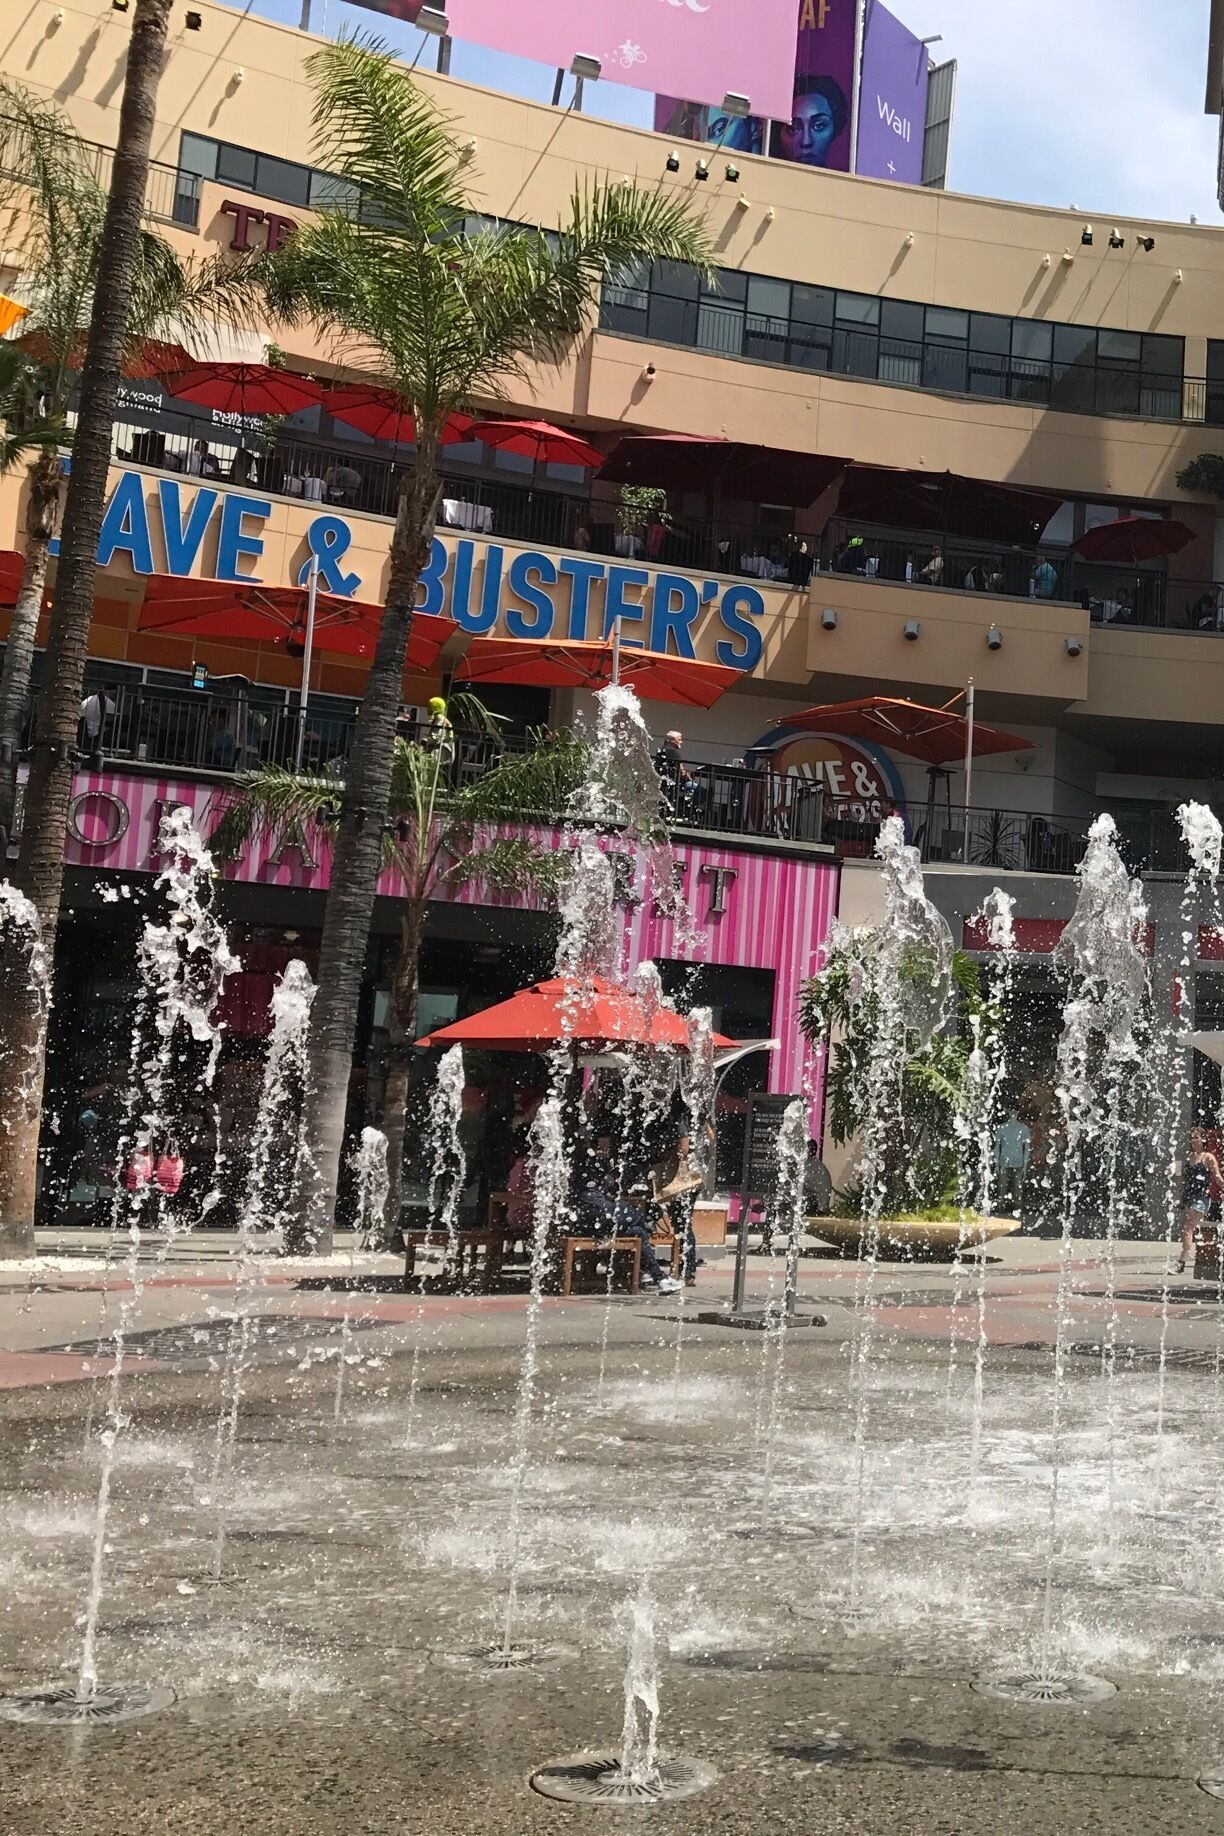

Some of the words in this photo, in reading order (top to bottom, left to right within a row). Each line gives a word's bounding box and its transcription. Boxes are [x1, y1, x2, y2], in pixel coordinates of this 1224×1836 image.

[876, 94, 911, 143] Wall
[48, 454, 272, 584] AVE
[298, 515, 362, 598] &
[851, 761, 879, 797] &
